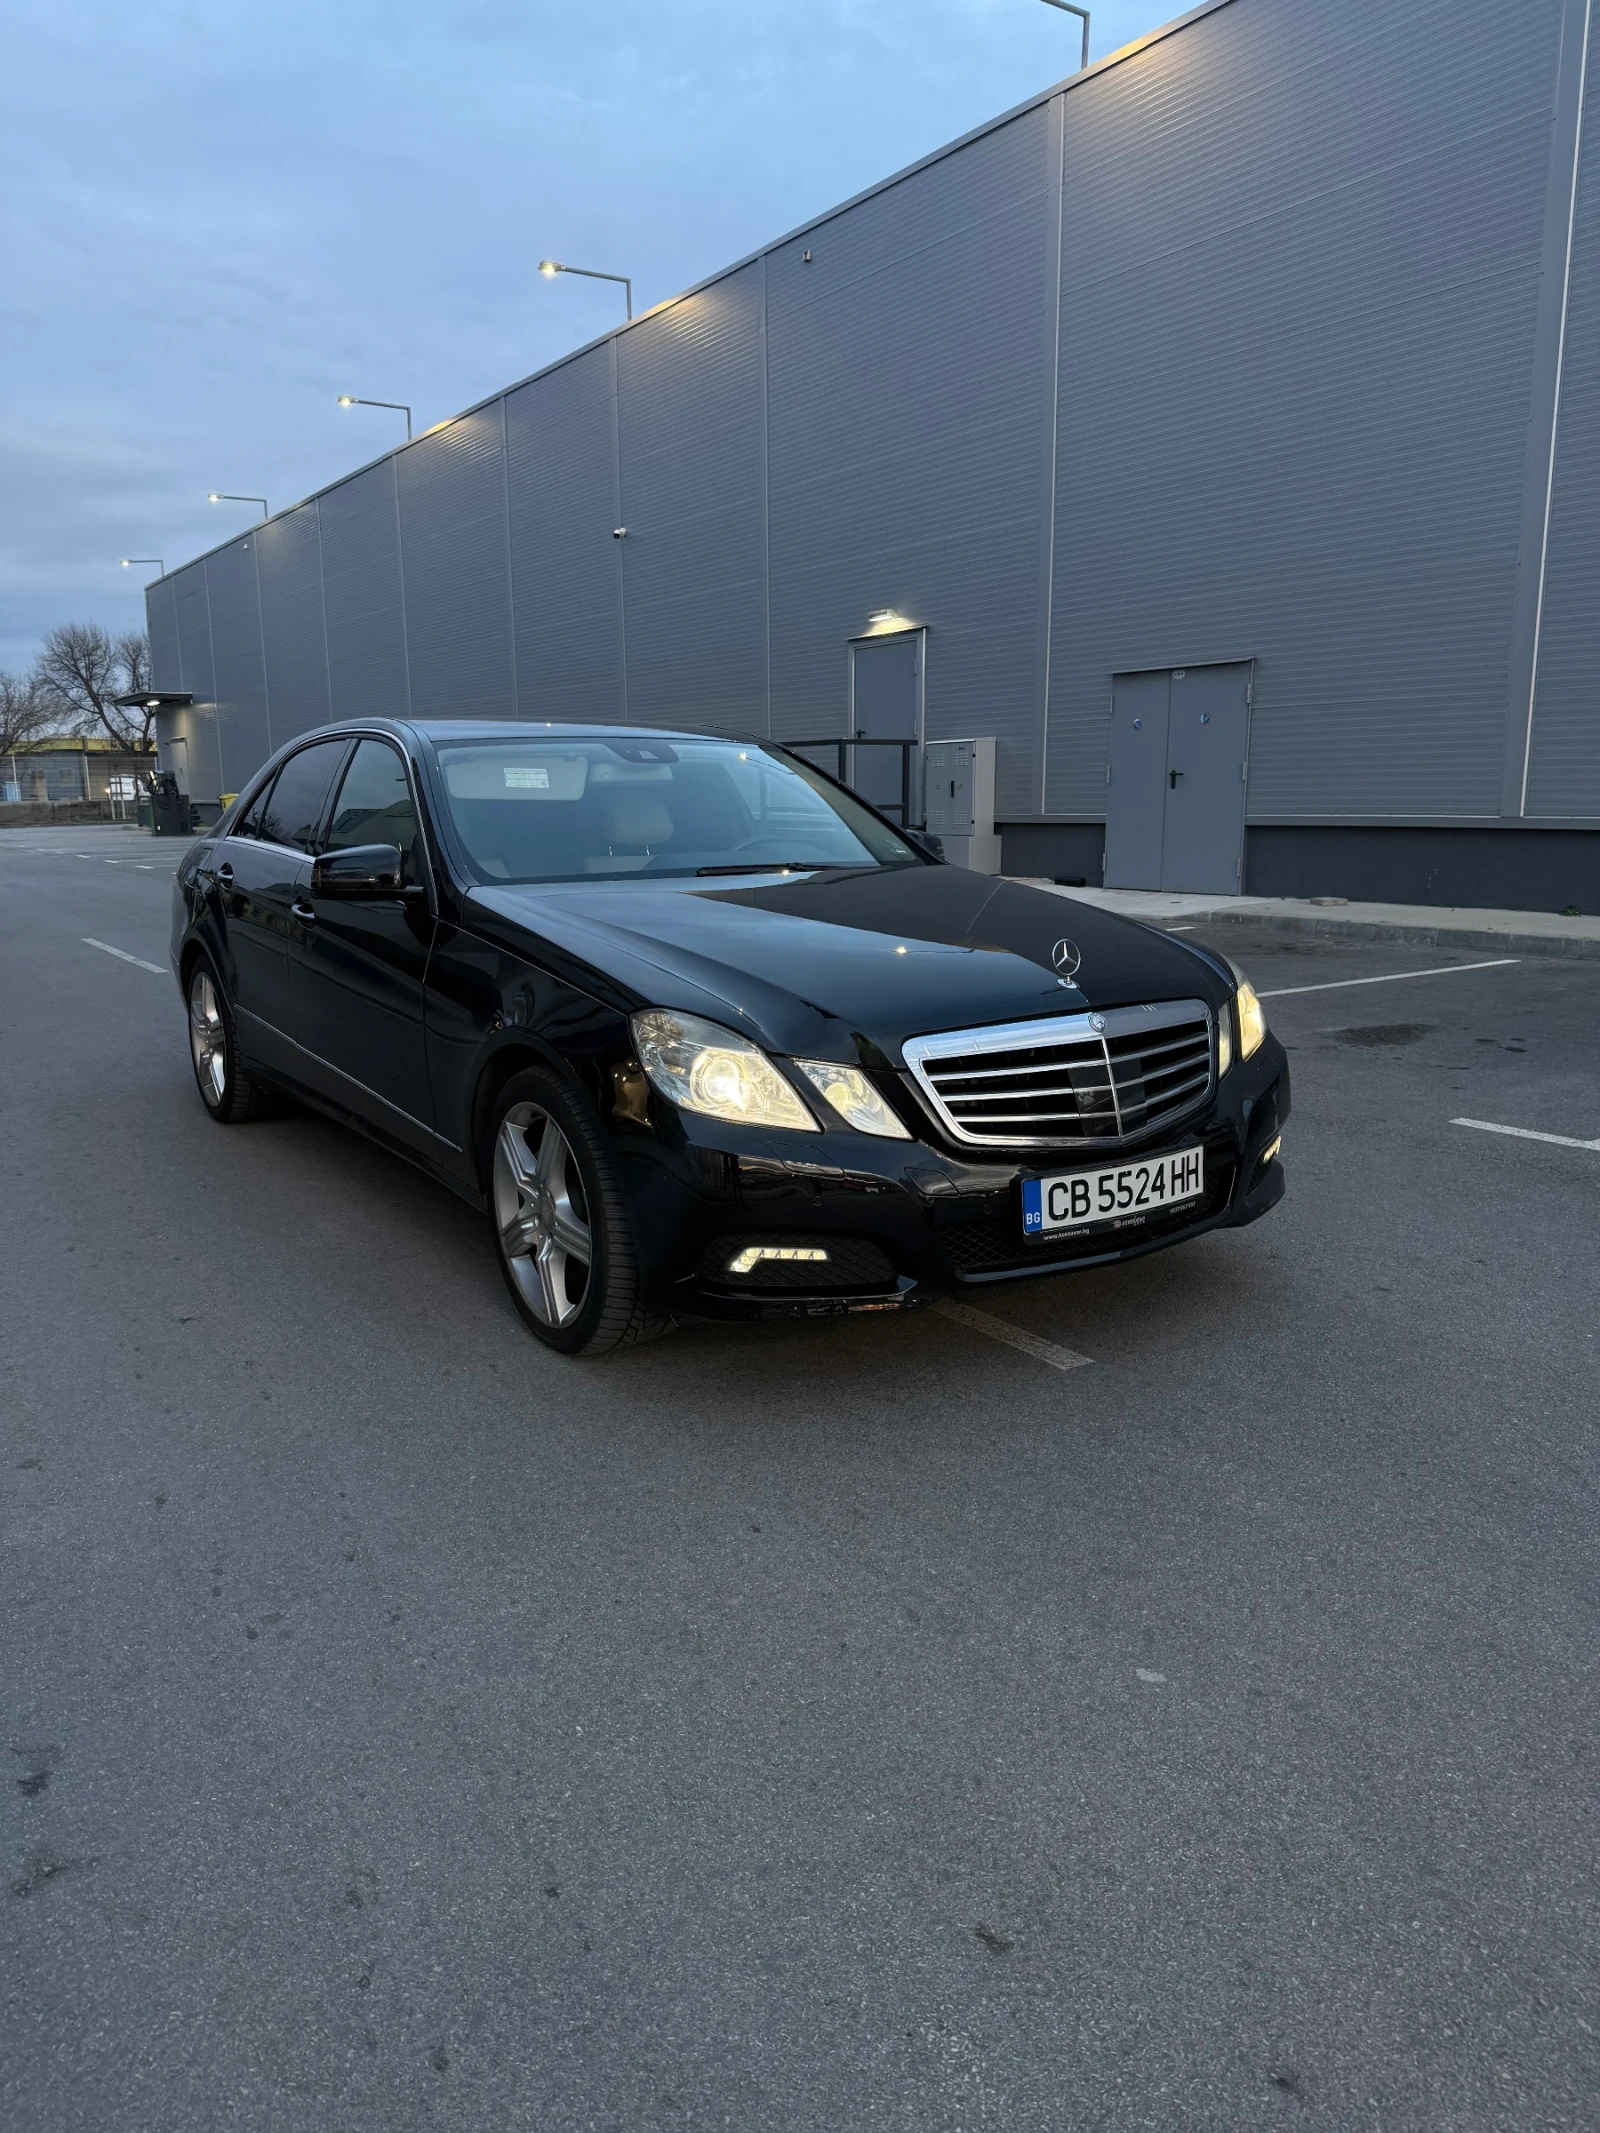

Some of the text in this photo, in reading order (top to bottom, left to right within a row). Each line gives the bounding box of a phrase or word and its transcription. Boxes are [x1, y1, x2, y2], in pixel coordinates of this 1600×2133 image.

[1048, 1152, 1199, 1221] CB 5524 HH
[1026, 1212, 1041, 1225] BG
